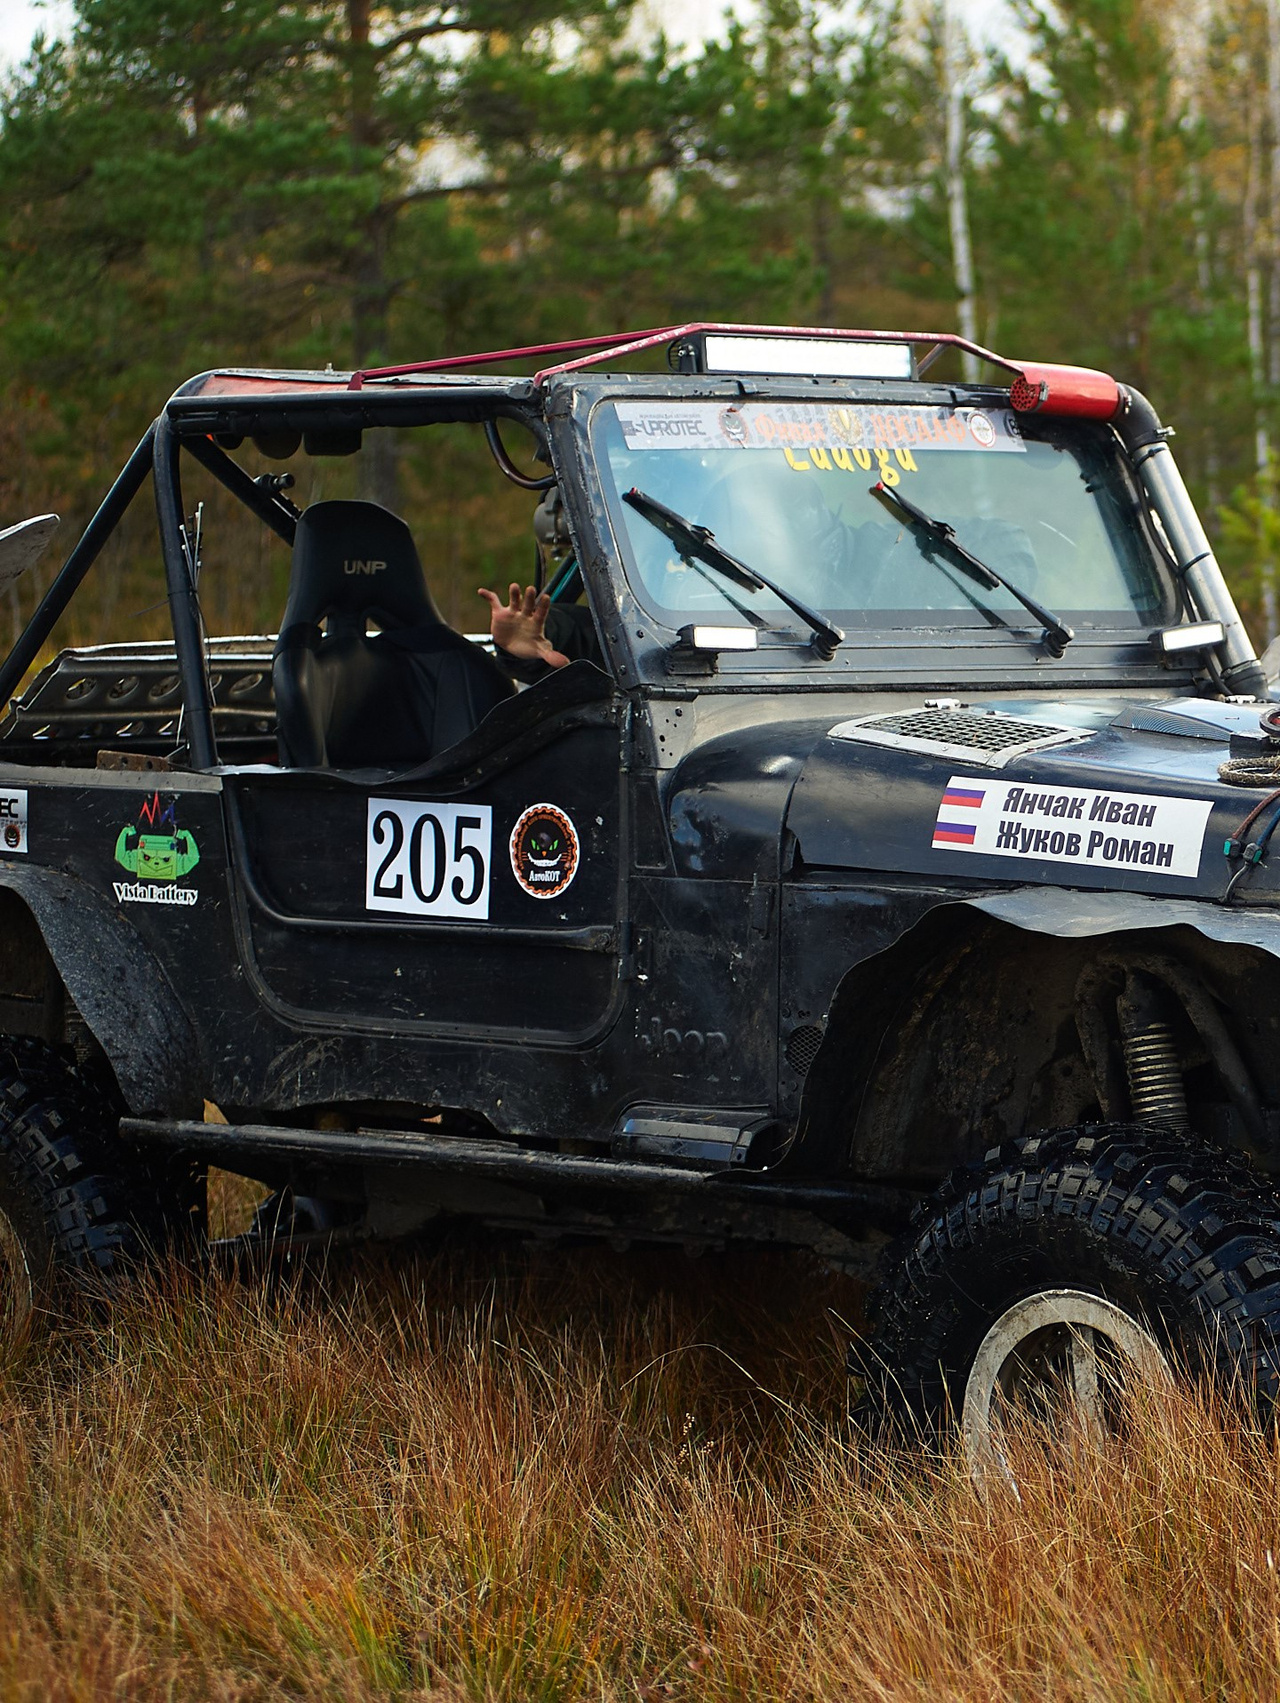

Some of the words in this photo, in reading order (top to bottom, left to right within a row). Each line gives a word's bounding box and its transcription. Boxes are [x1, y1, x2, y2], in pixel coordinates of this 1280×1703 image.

[869, 413, 967, 448] ДОСААФ
[344, 560, 387, 575] UNP
[1002, 787, 1087, 819] Янчак
[1088, 795, 1157, 827] Иван
[372, 810, 485, 906] 205
[995, 820, 1081, 857] Жуков
[1086, 830, 1174, 868] Роман
[112, 881, 148, 904] Vista
[148, 883, 199, 906] Battery
